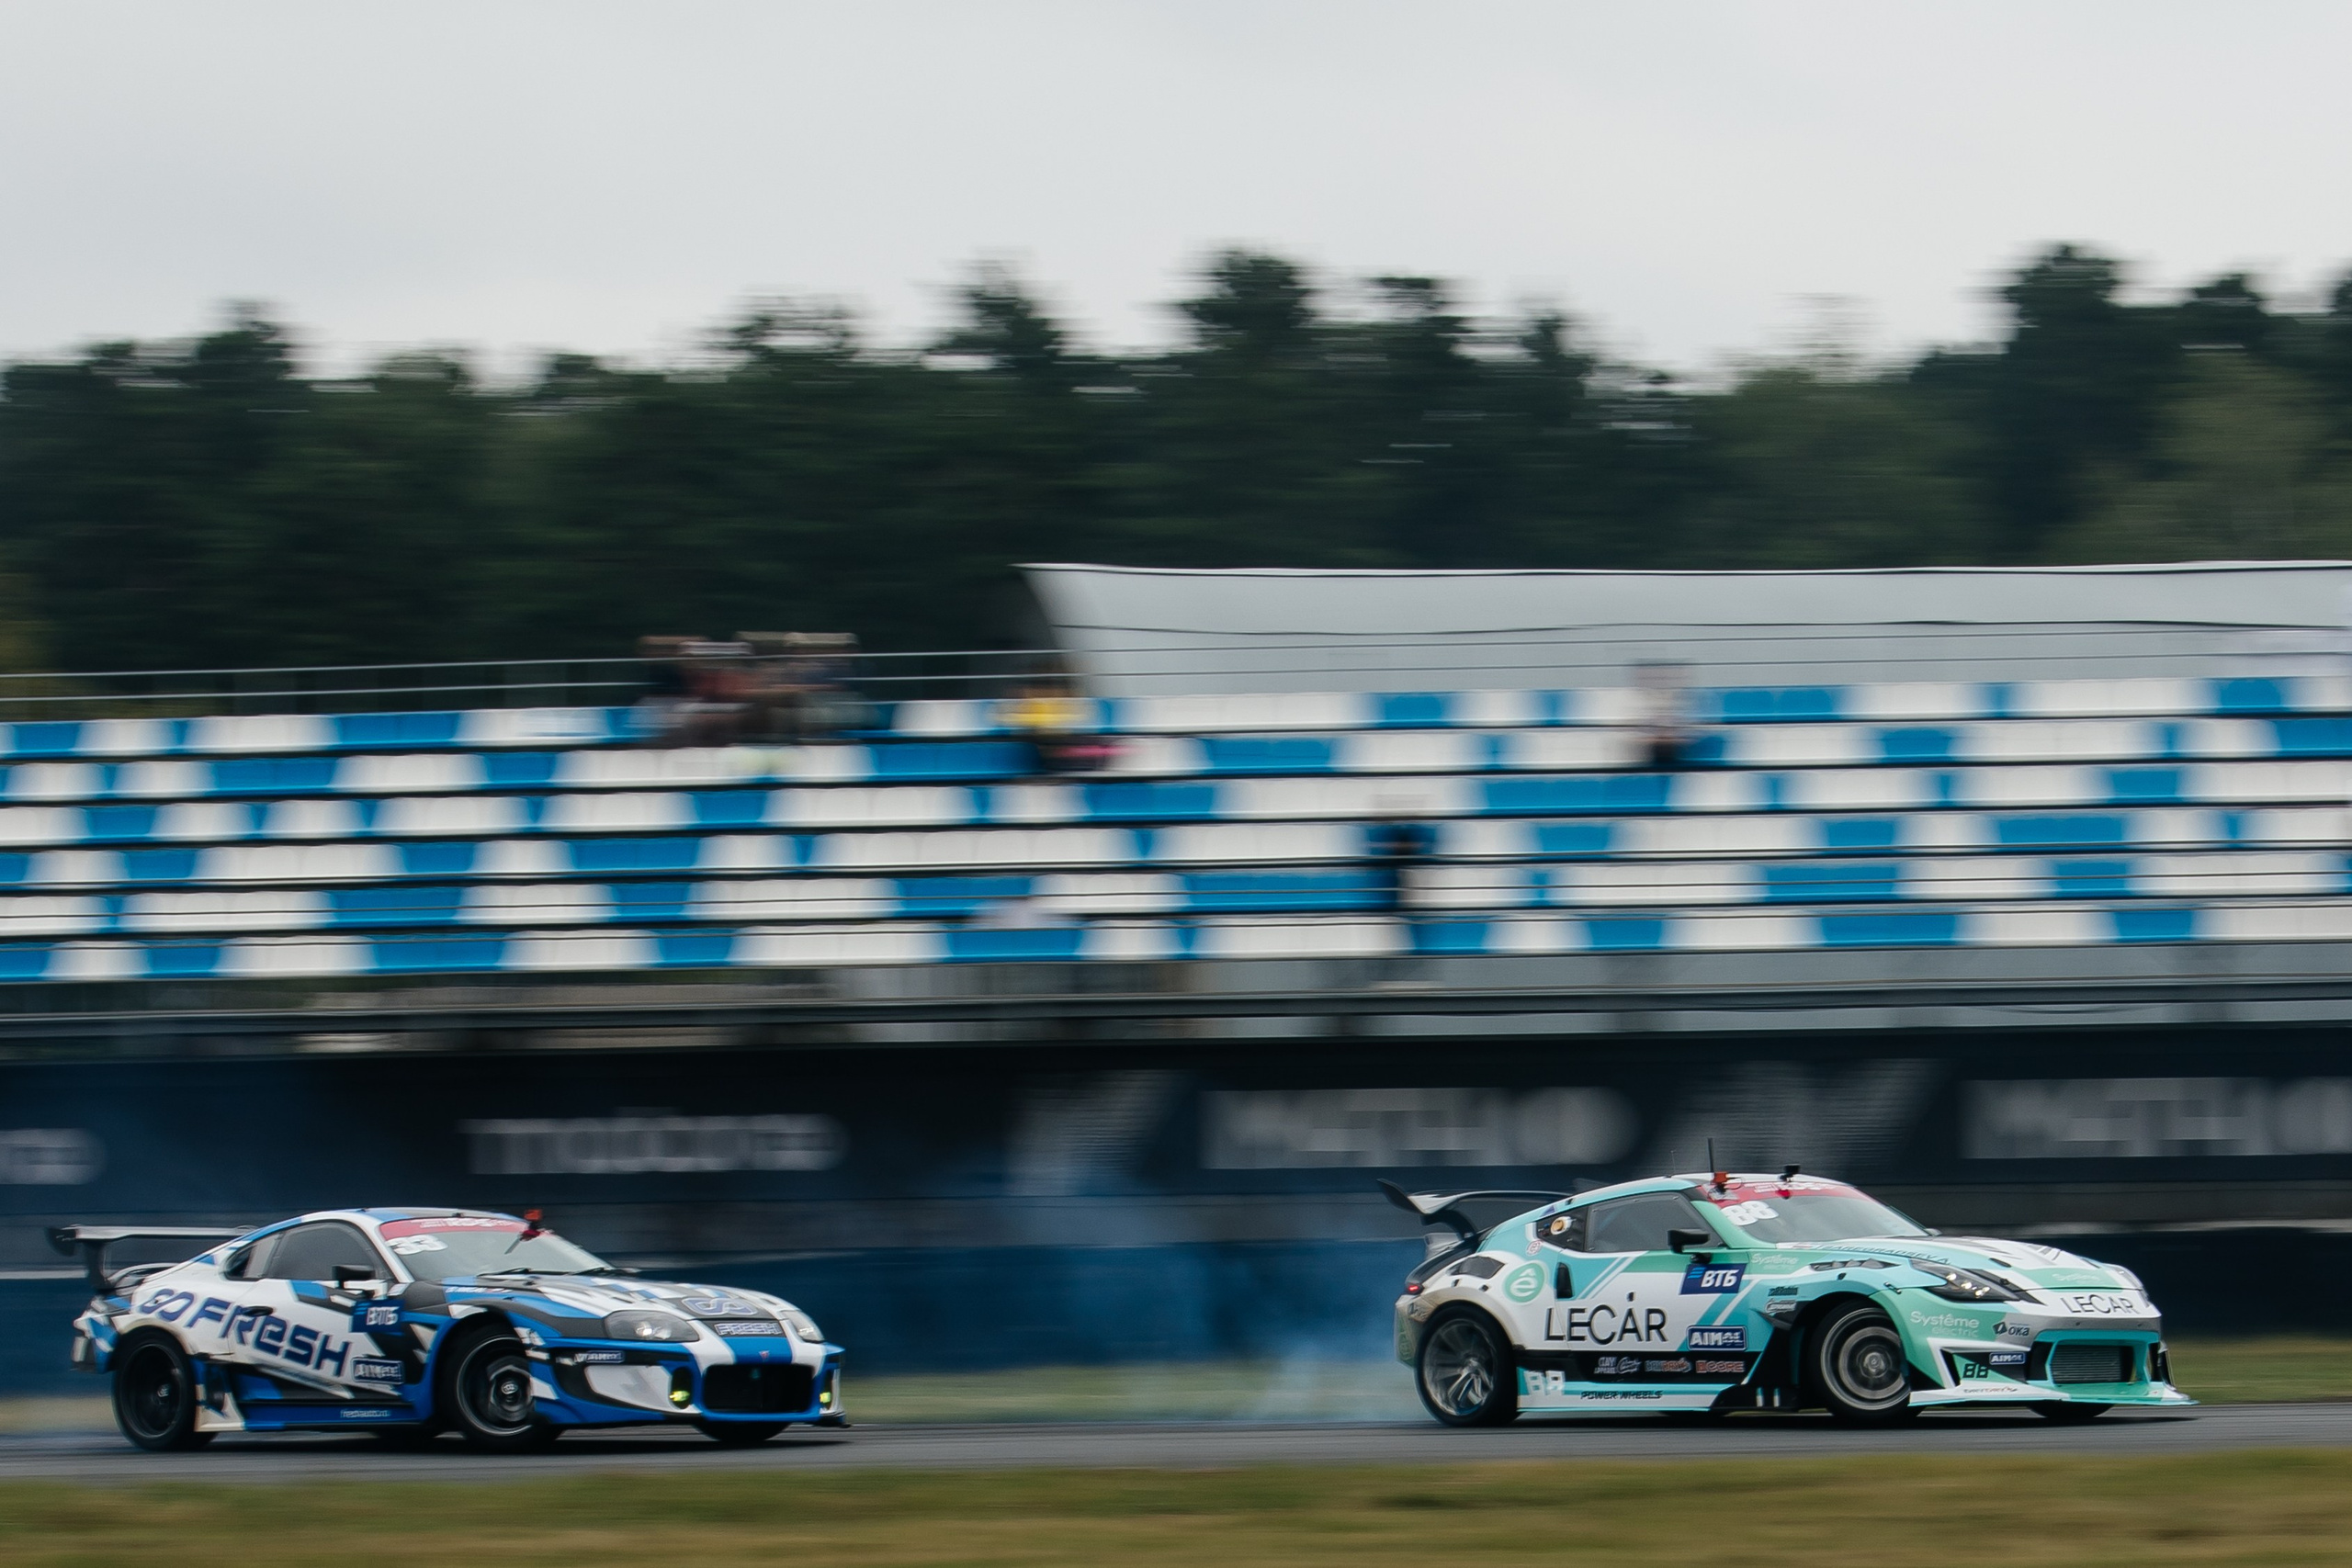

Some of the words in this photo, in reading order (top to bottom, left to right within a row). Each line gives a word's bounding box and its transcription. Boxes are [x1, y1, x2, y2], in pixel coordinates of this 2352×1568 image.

[1720, 1201, 1779, 1225] 88
[385, 1235, 448, 1255] 33
[1701, 1269, 1740, 1287] ВТБ
[2060, 1294, 2139, 1314] LECAR
